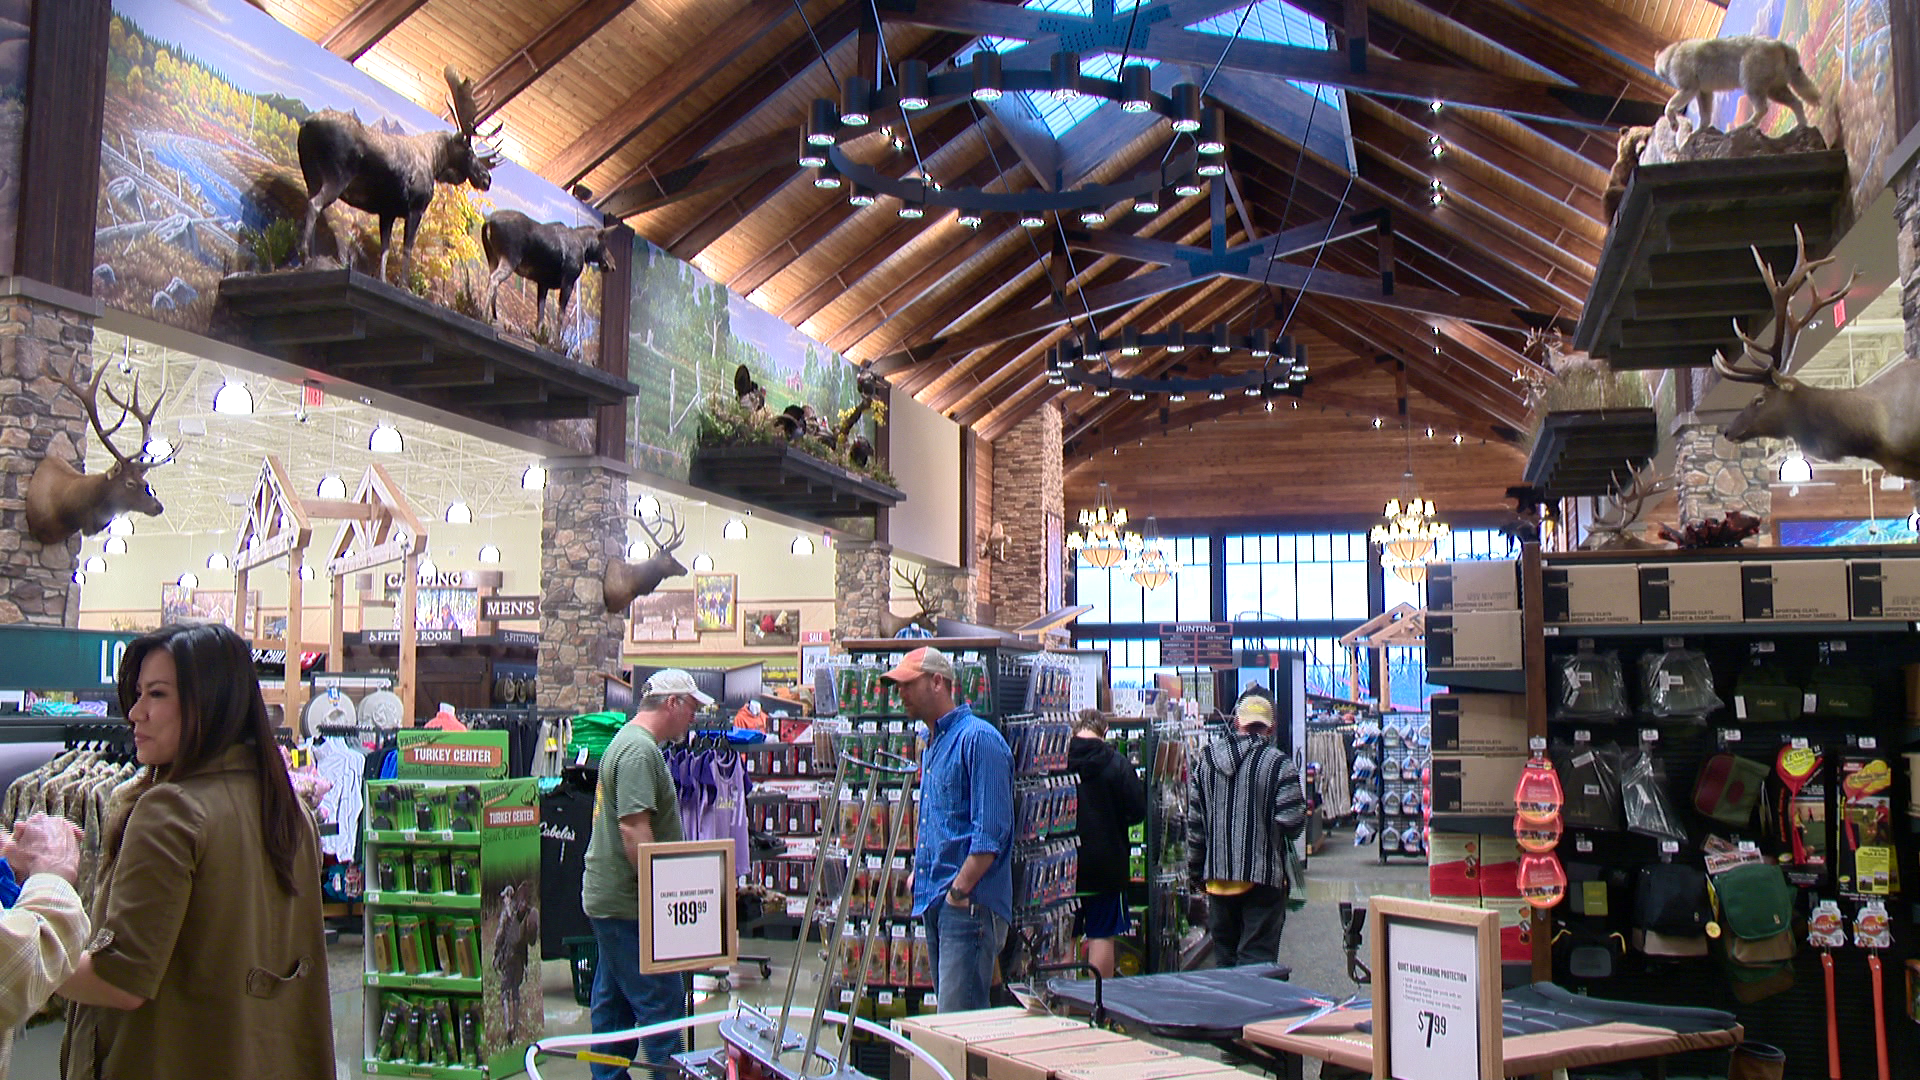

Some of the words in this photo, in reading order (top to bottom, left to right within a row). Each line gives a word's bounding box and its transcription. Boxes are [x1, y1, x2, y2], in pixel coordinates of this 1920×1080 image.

[486, 601, 535, 615] MEN'S
[1175, 625, 1216, 633] HUNTING
[378, 631, 419, 641] FITT
[421, 631, 452, 641] ROOM
[510, 632, 536, 644] FITTING
[808, 632, 823, 642] SALE
[414, 748, 451, 761] TURKEY
[453, 749, 491, 763] CENTER
[490, 811, 512, 825] TURKEY
[513, 809, 535, 823] CENTER
[1397, 961, 1409, 972] QUIET
[1409, 964, 1421, 975] BAND
[1422, 965, 1441, 978] HEARING
[1441, 969, 1467, 983] PROTECTION
